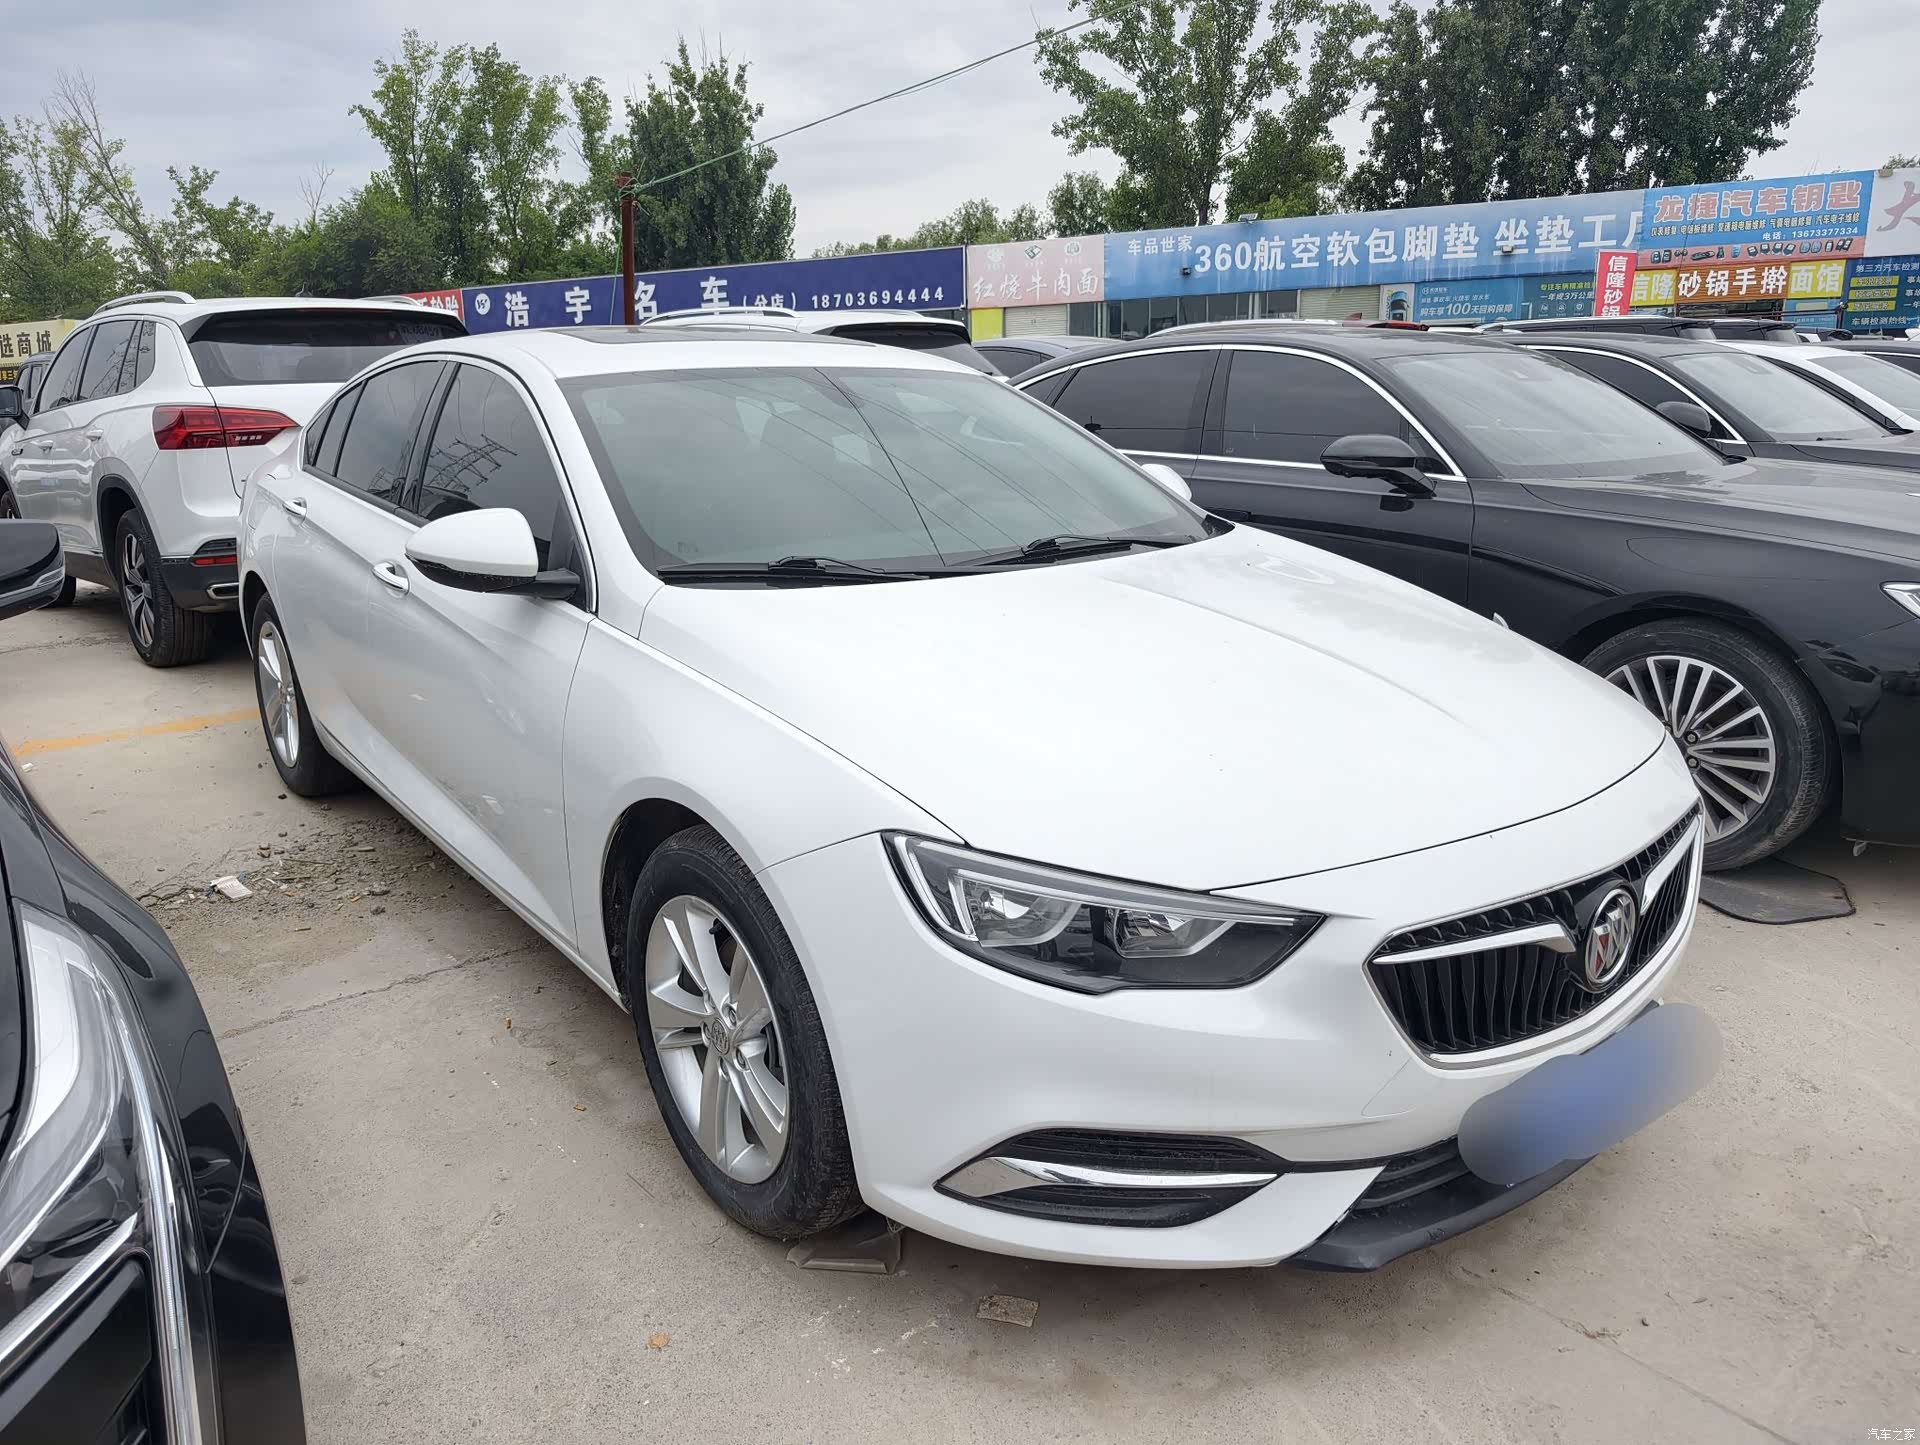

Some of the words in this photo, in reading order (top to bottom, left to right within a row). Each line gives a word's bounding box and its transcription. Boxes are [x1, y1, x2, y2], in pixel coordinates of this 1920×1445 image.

[1127, 234, 1193, 256] 车品世家
[811, 286, 944, 309] 18703694444
[973, 267, 1099, 302] 红烧牛肉面
[504, 276, 730, 328] 浩宇名车
